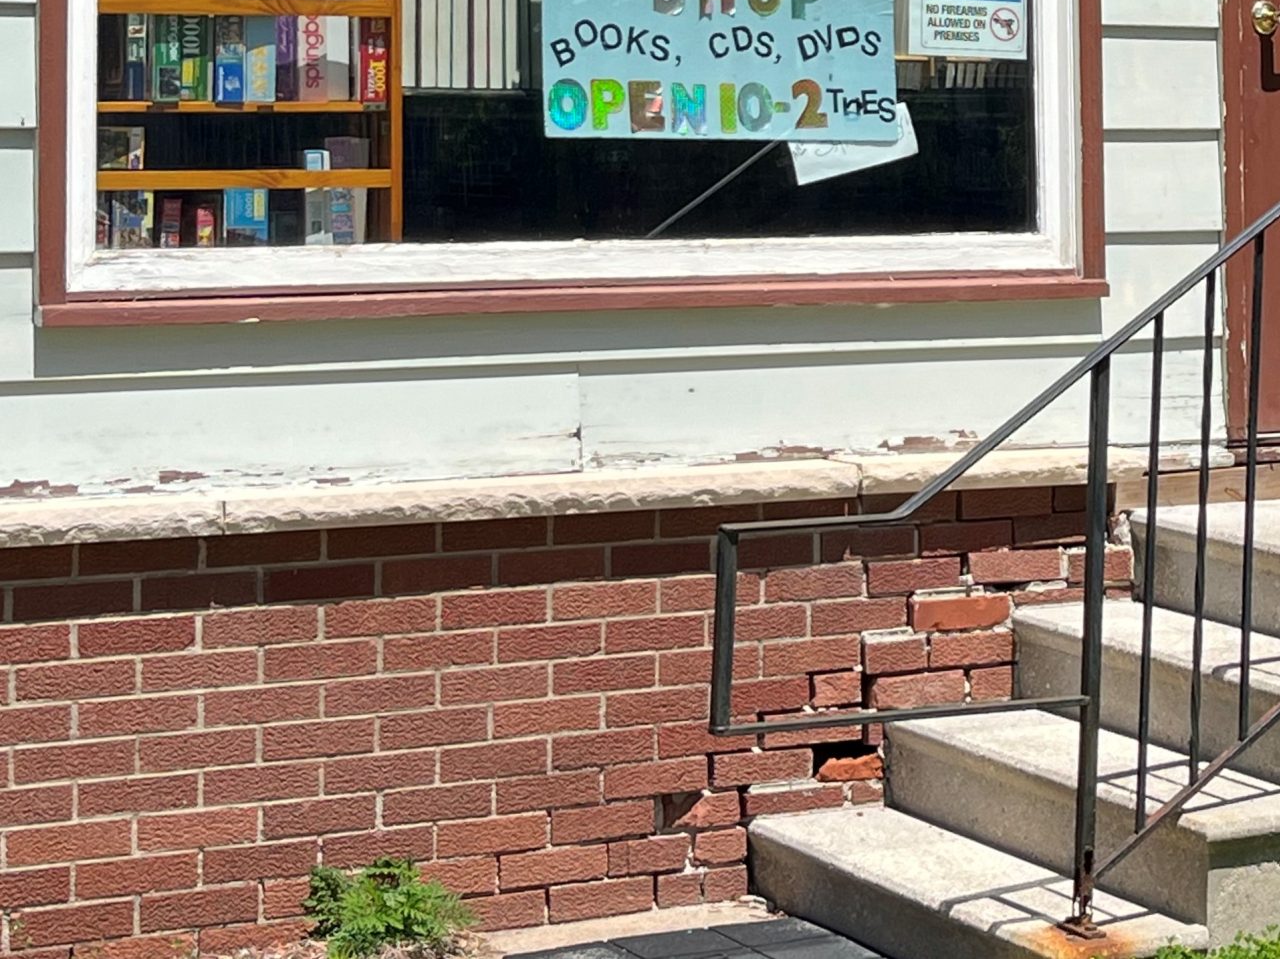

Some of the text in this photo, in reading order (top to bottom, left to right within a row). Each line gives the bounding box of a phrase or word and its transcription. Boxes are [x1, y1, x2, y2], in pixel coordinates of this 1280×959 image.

[925, 4, 988, 16] NO FIREARMS
[927, 17, 986, 30] ALLOWED ON
[550, 19, 883, 67] BOOKS, CDS, DVDS
[933, 30, 980, 42] PREMISES
[302, 14, 324, 89] springb
[548, 78, 708, 136] OPEN
[718, 78, 828, 135] 10-2
